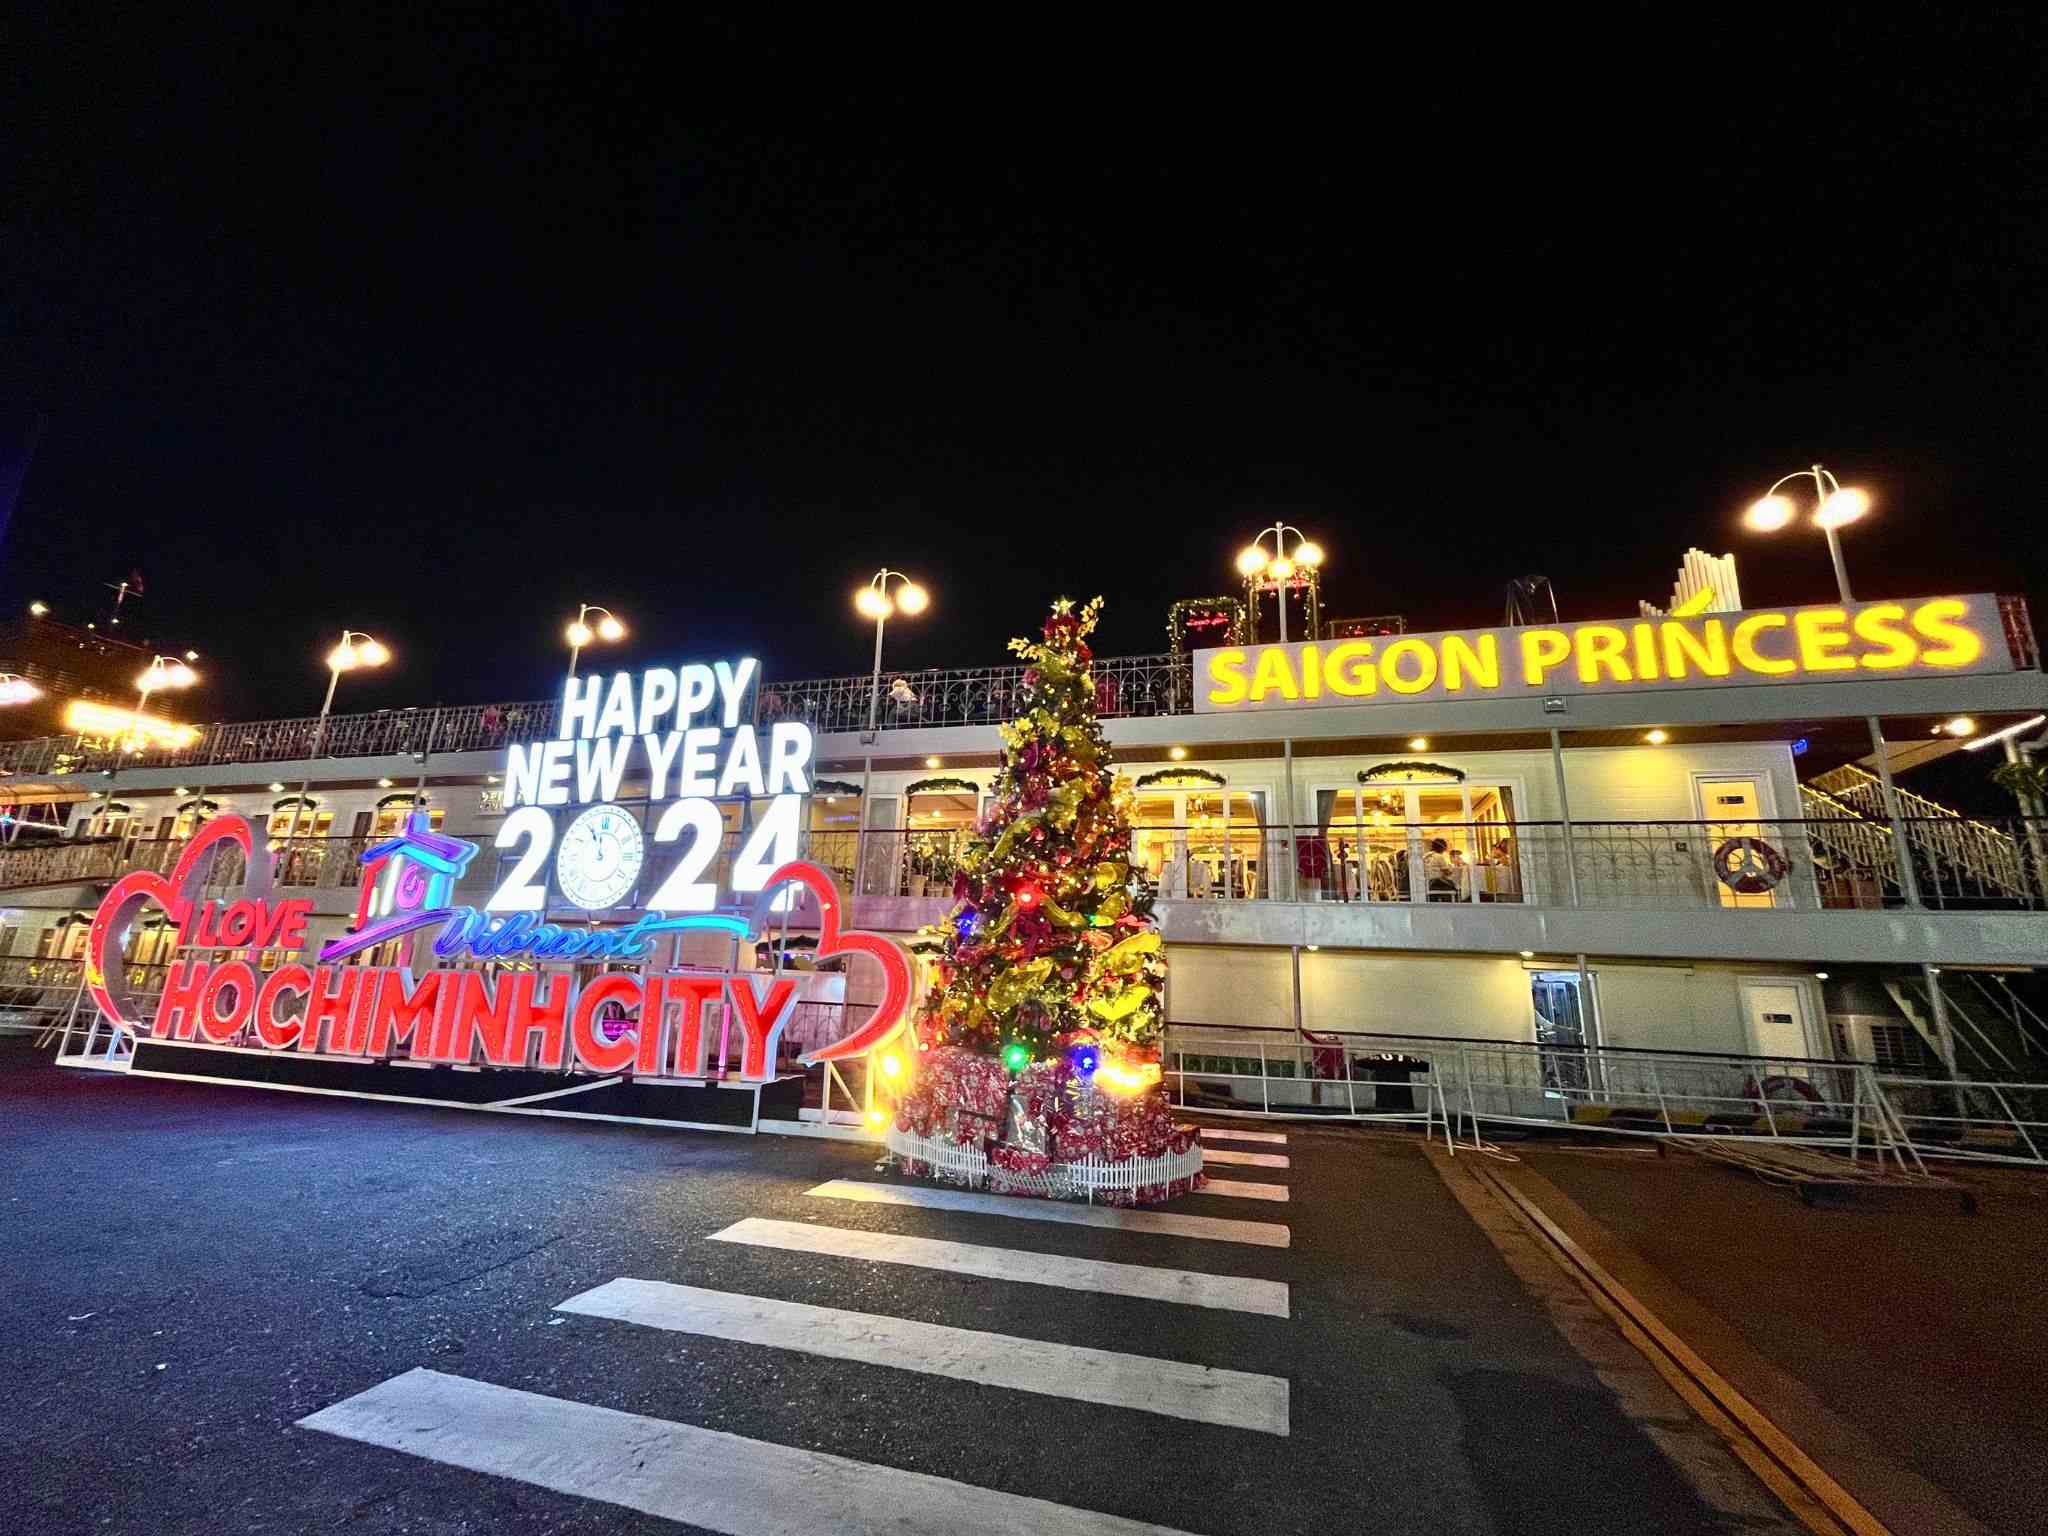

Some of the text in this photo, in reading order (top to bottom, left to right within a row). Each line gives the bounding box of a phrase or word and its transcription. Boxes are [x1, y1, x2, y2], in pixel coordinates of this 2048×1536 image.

[560, 657, 758, 740] HAPPY
[1208, 632, 1499, 704] SAIGON
[502, 722, 813, 806] NEW YEAR
[199, 898, 314, 948] LOVE
[432, 906, 664, 957] Vibrant
